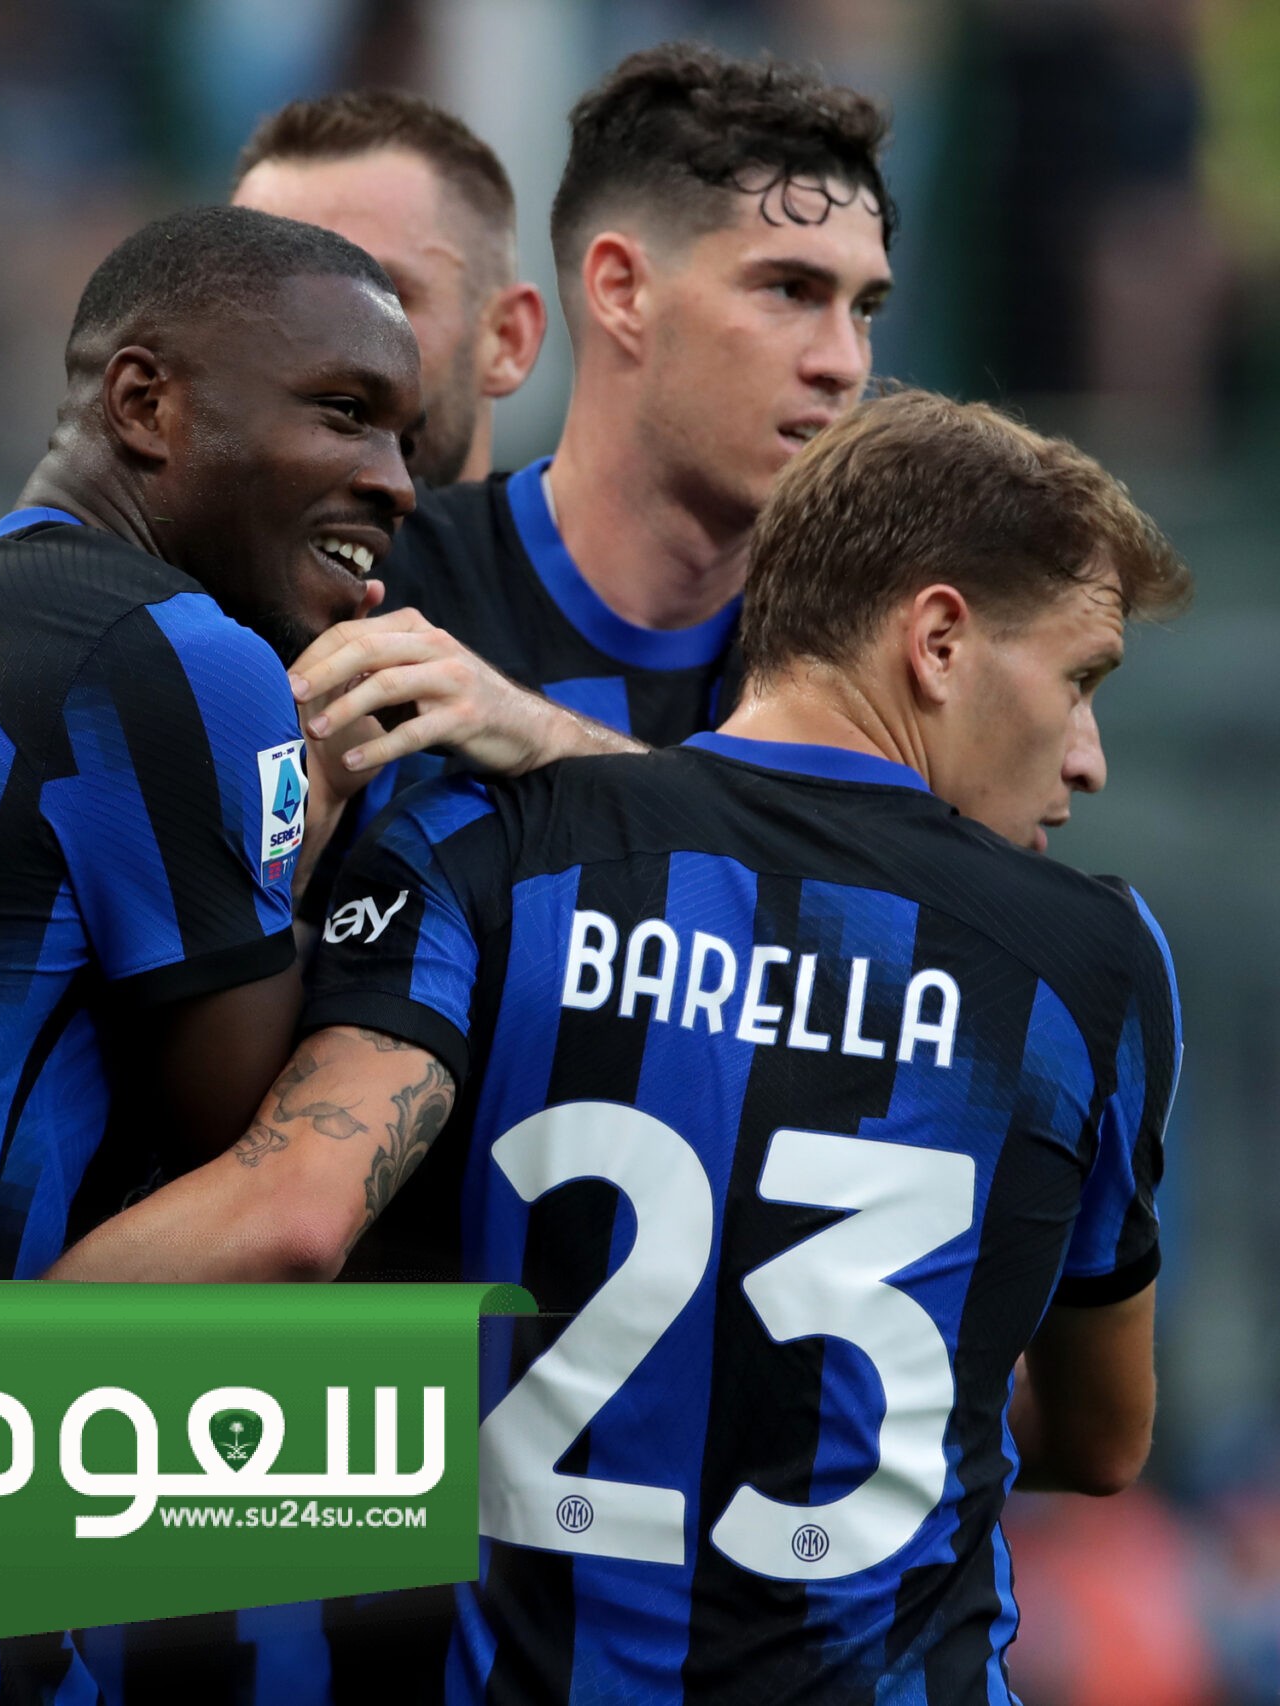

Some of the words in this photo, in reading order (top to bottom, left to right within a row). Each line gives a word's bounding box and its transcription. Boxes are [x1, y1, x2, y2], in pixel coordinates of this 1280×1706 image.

[270, 826, 296, 847] SERIE
[561, 909, 963, 1069] BARELLA
[479, 1100, 977, 1581] 23
